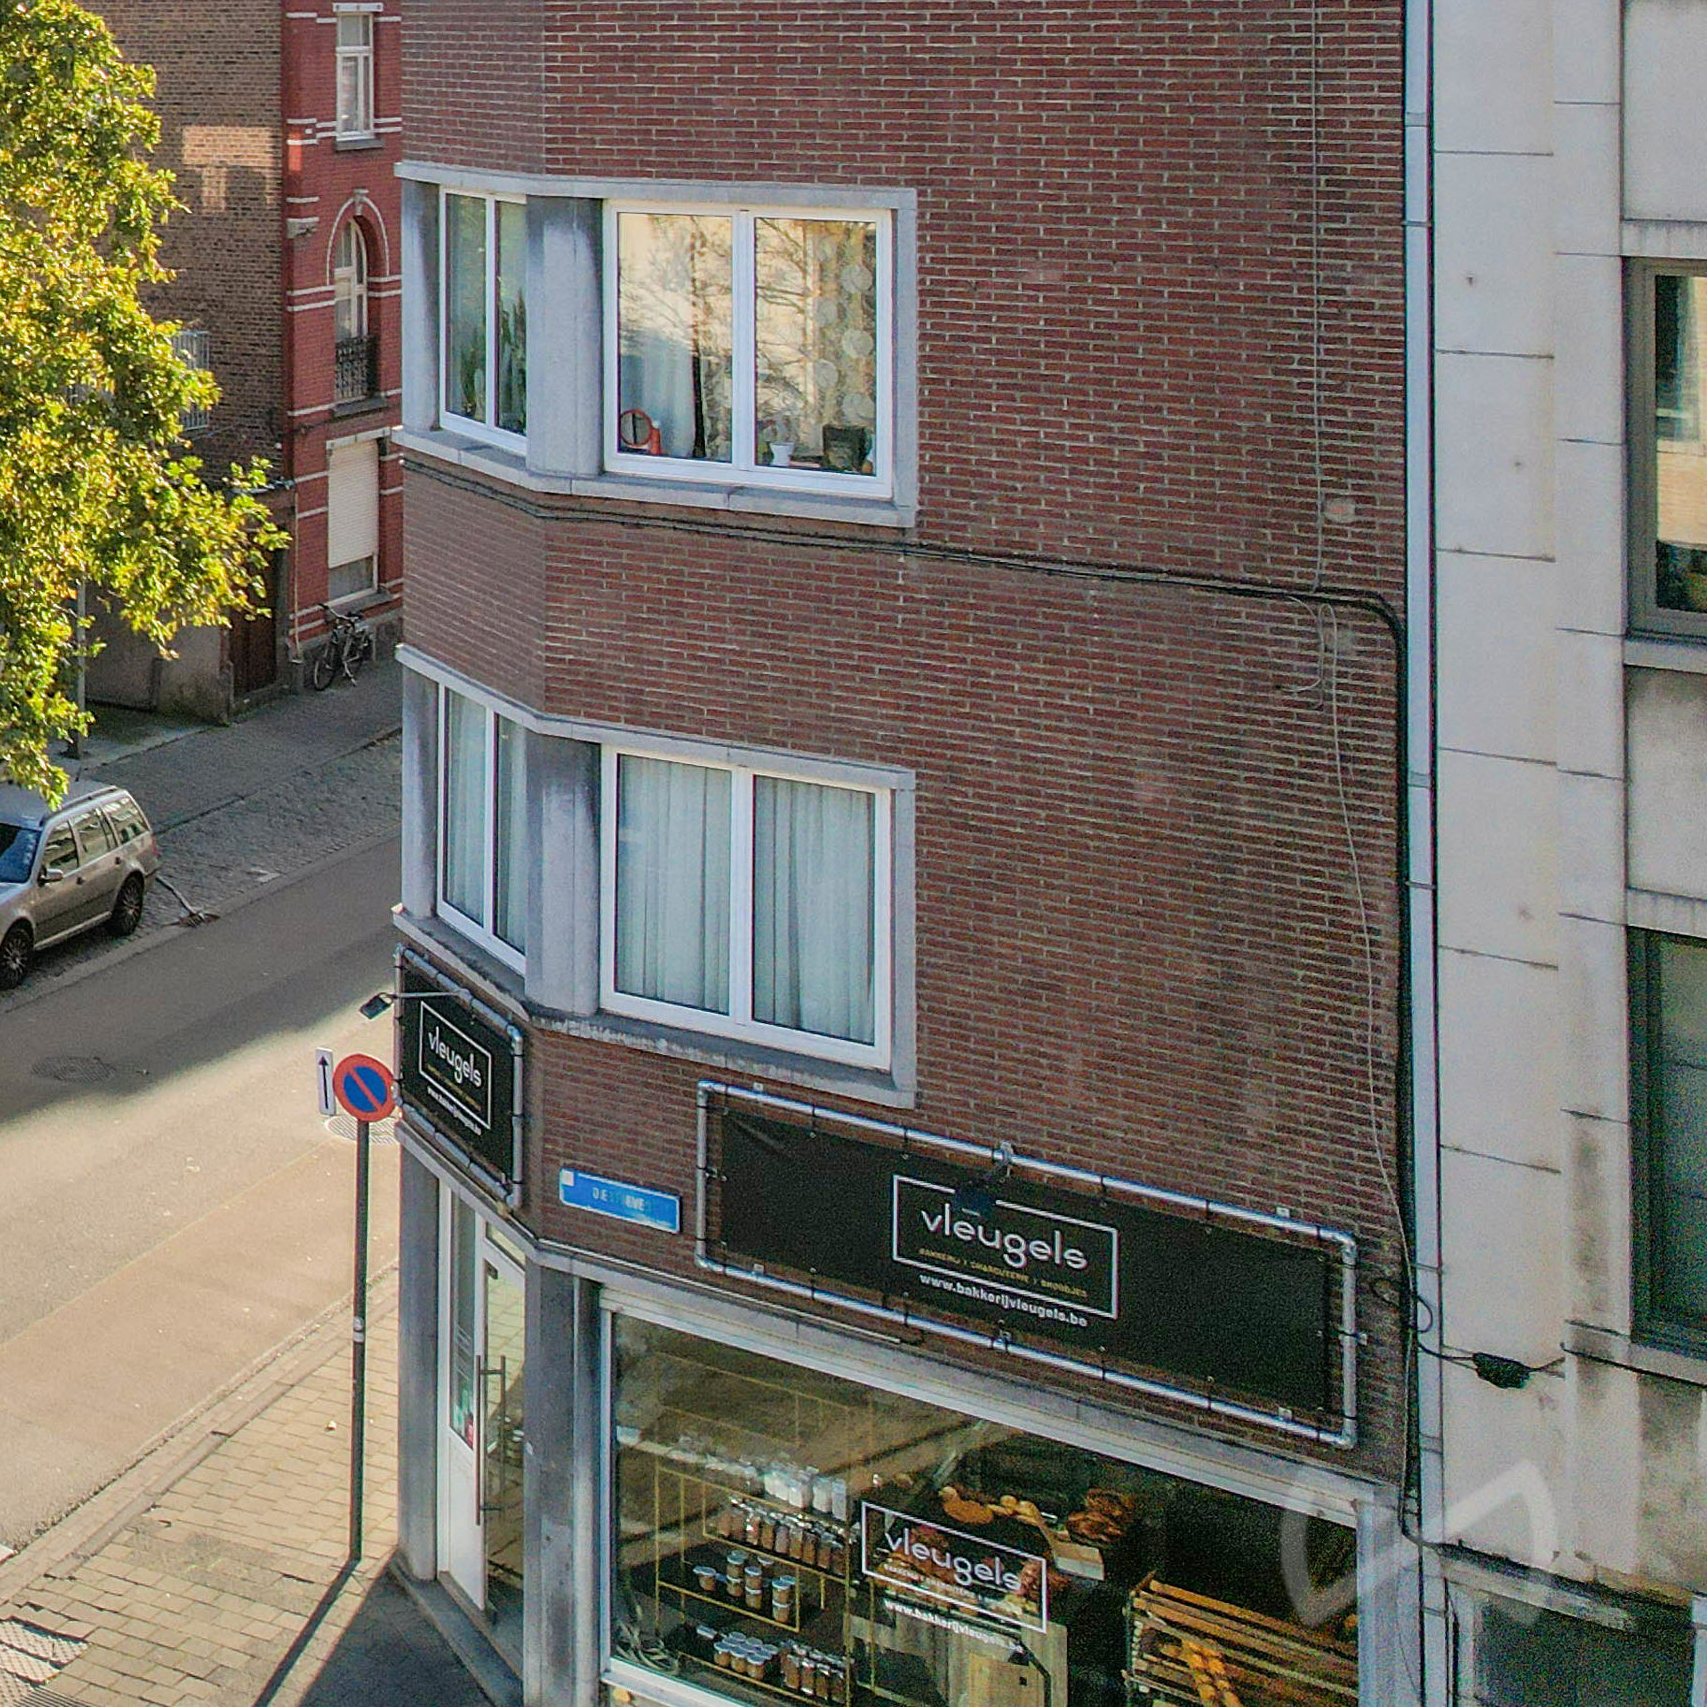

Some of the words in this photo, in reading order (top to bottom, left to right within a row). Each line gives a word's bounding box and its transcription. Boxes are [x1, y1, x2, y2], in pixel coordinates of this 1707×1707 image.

[428, 1025, 482, 1087] vleugels
[921, 1203, 1088, 1268] vleugels
[919, 1273, 1087, 1327] www.bakkerijvleugels.be
[885, 1527, 1021, 1591] vleugels
